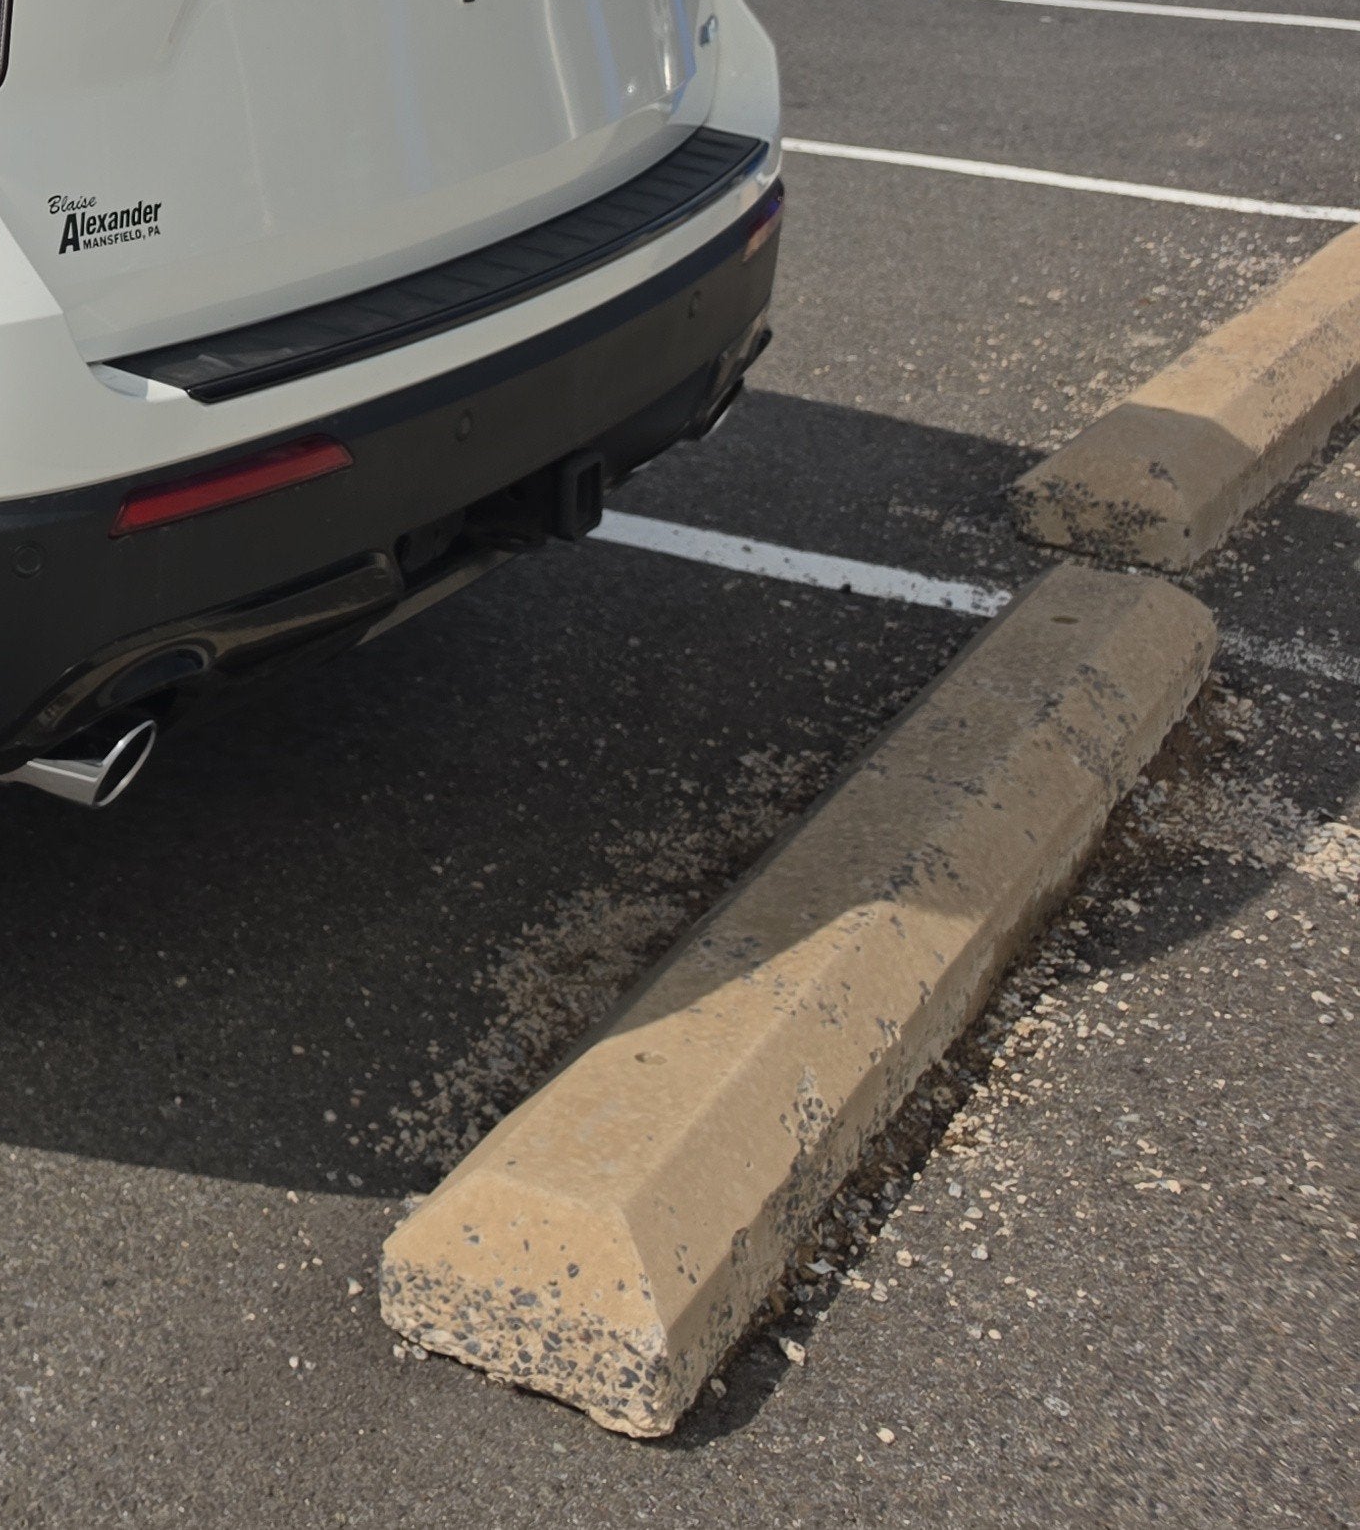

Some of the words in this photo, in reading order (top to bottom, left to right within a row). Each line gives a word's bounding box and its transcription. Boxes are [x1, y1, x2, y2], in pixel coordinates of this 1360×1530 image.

[47, 195, 97, 214] Blaise
[59, 200, 162, 254] Alexander
[83, 229, 146, 249] MANSFIELD,
[147, 225, 161, 237] PA
